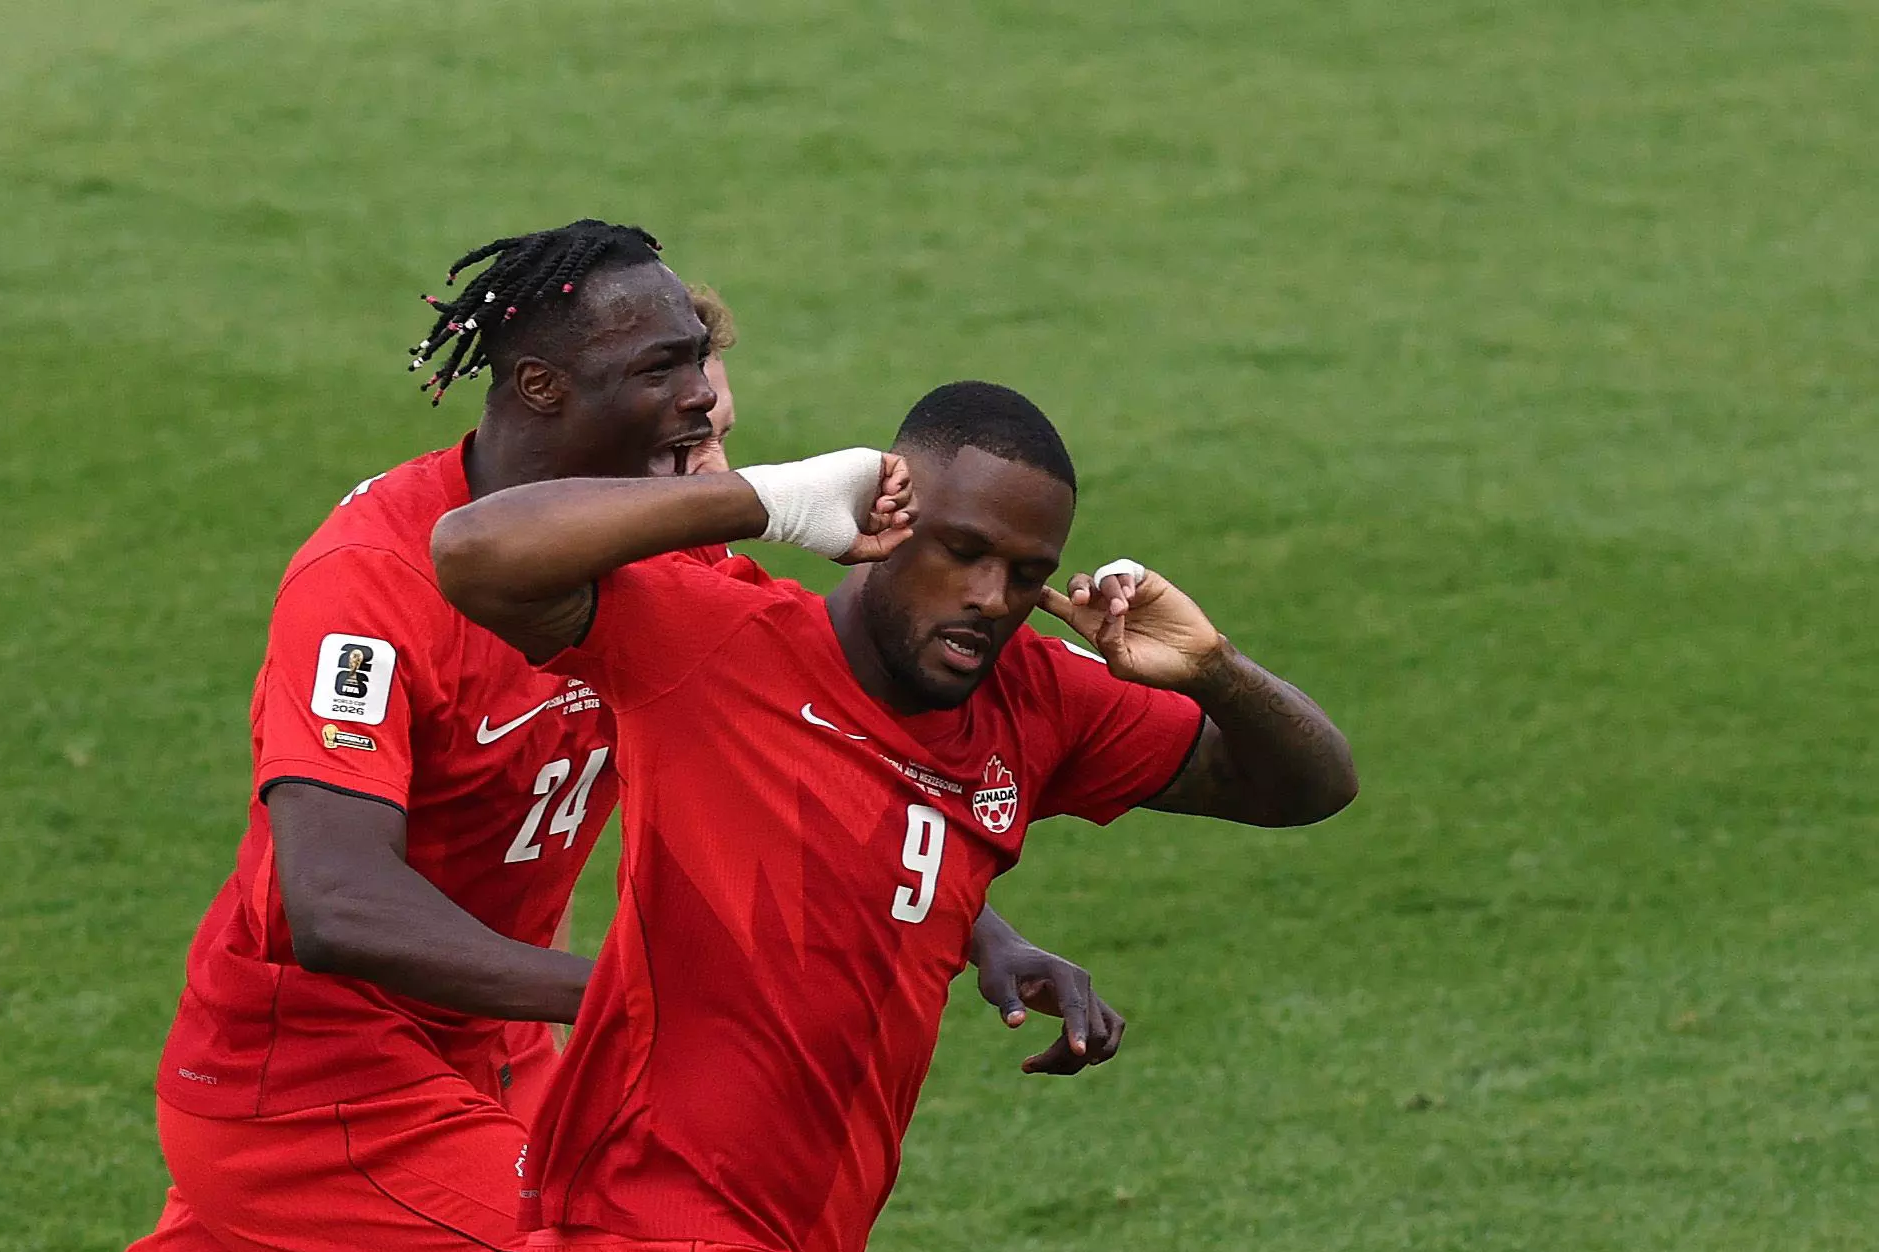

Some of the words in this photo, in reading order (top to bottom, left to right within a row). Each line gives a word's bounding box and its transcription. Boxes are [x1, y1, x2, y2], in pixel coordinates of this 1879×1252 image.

[332, 704, 365, 716] 2026
[504, 746, 609, 863] 24
[974, 789, 1015, 804] CANADA
[891, 804, 946, 923] 9
